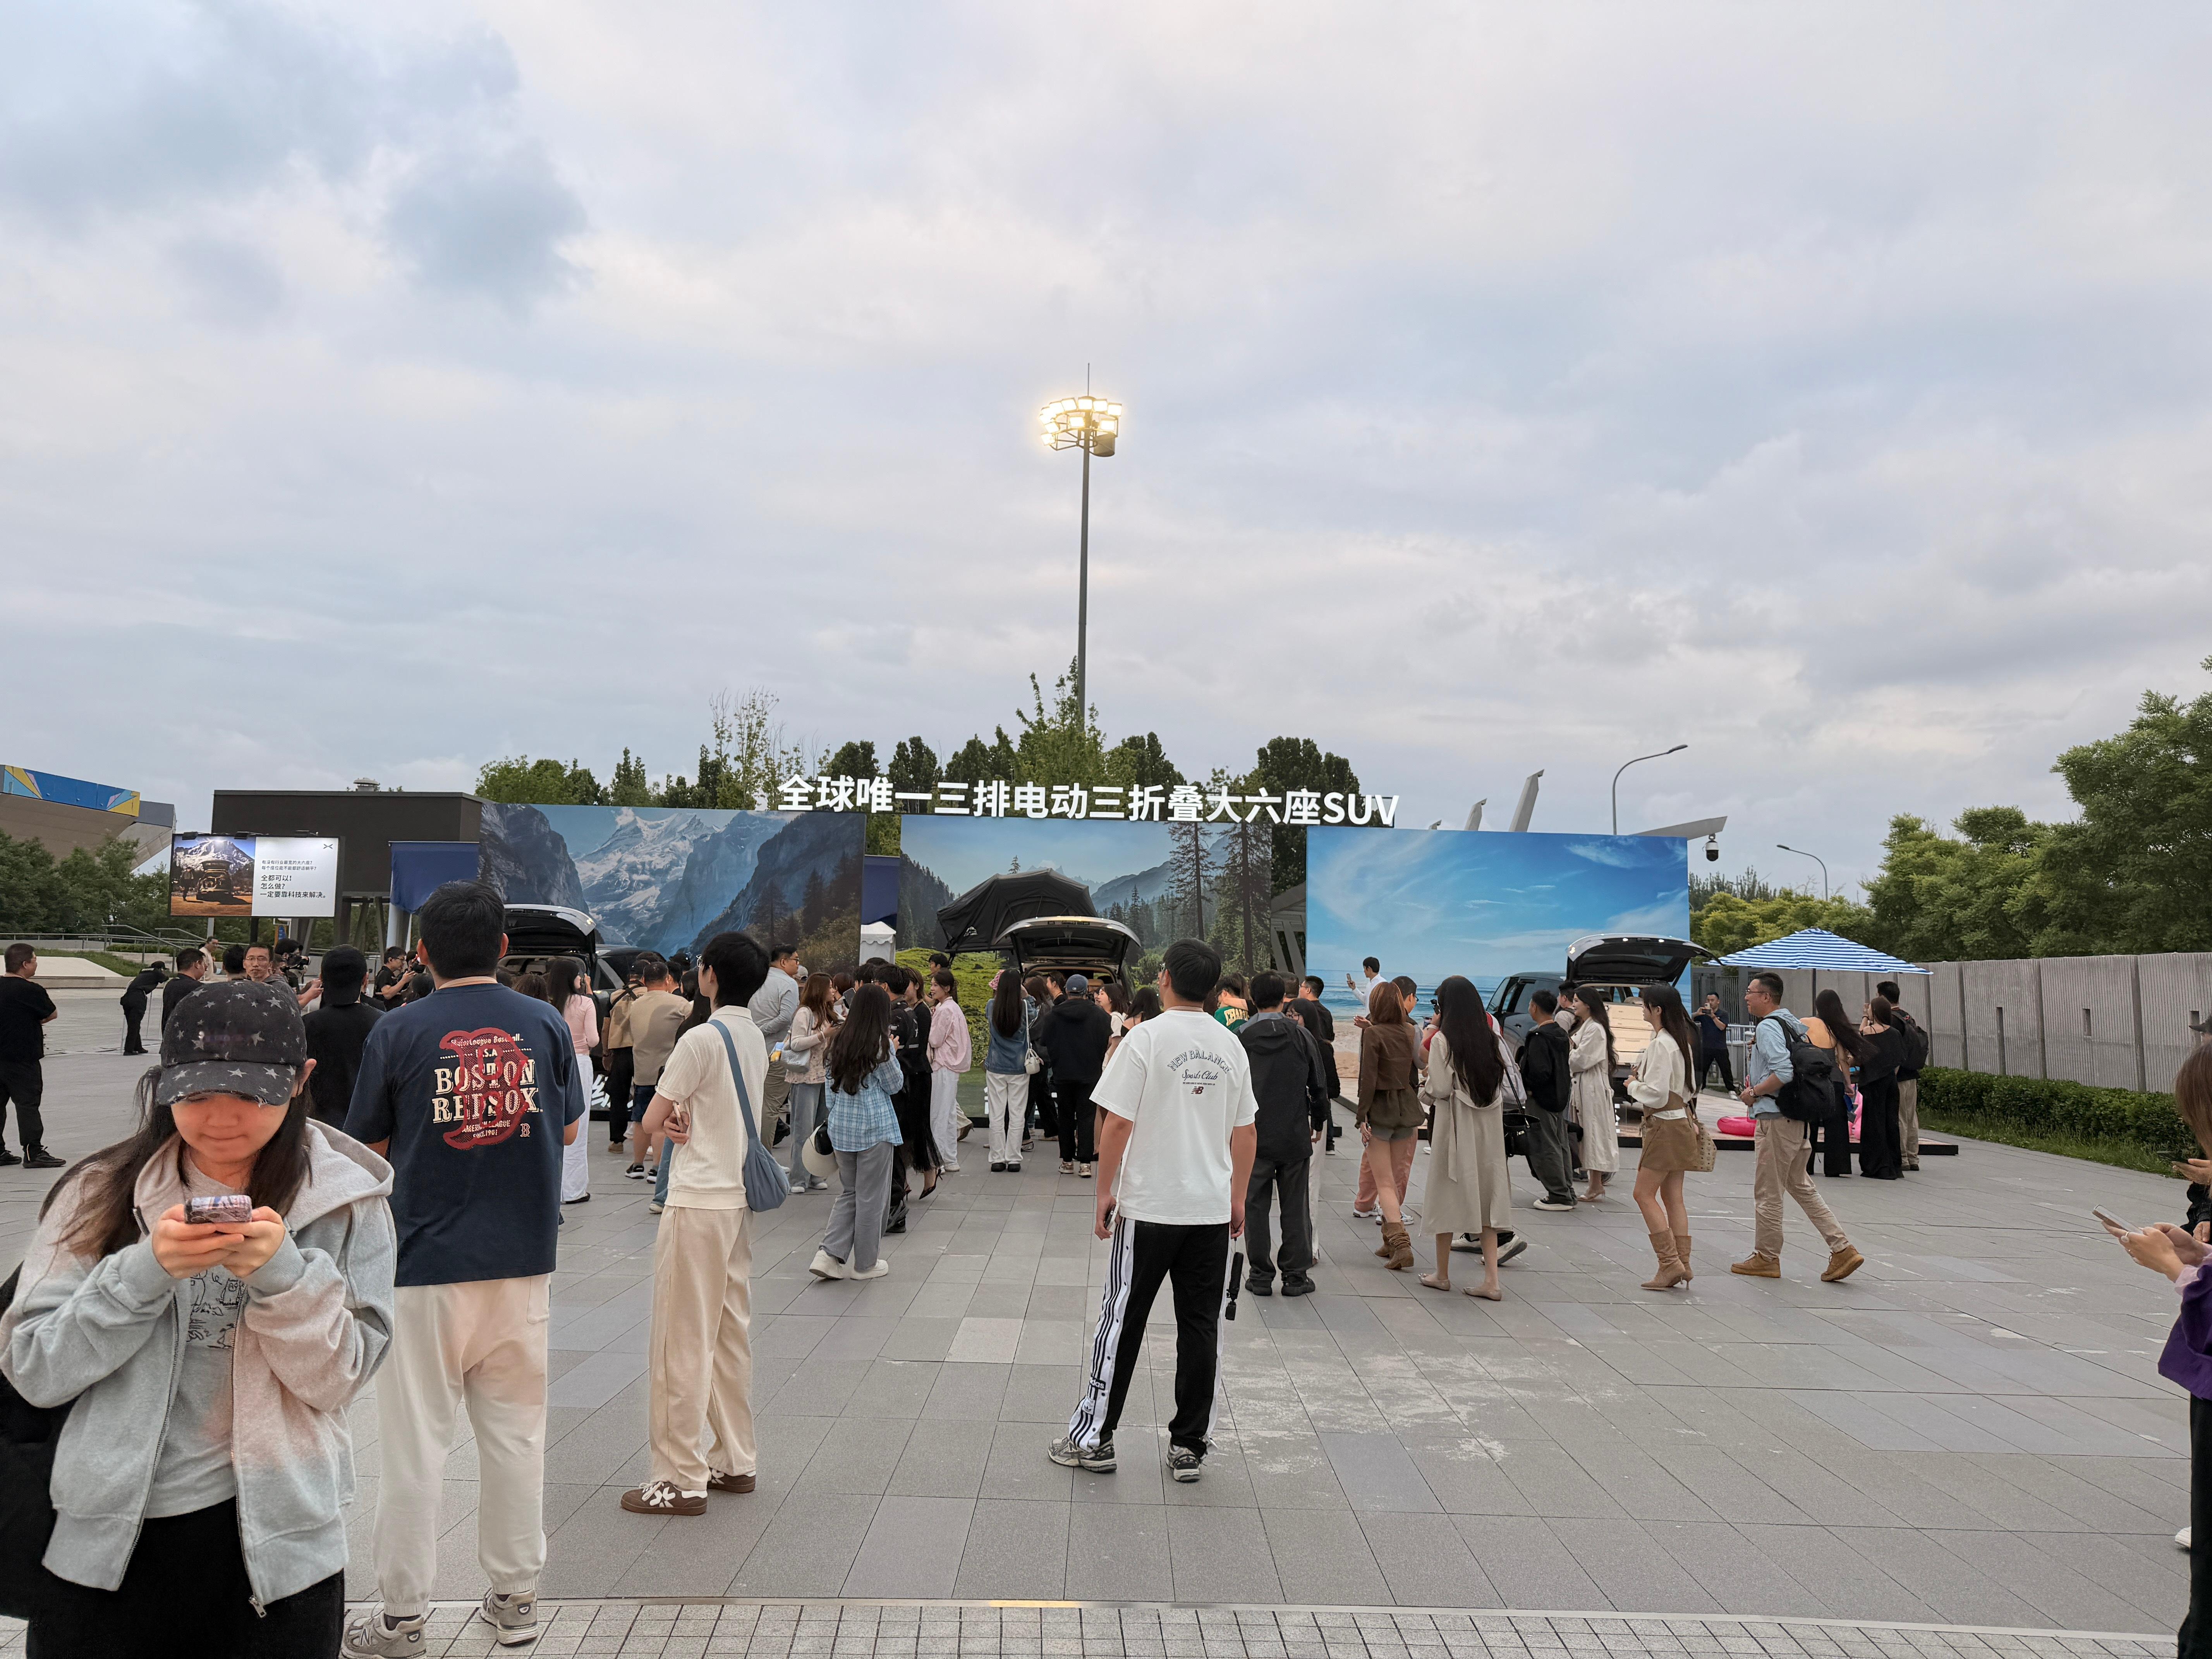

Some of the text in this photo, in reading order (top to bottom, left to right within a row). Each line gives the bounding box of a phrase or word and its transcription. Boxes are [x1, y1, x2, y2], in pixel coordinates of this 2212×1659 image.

[778, 774, 1399, 825] 全球唯一三排电动三折叠大六座SUV
[1167, 1049, 1232, 1073] NEW BALANCE
[1202, 1071, 1219, 1080] Club
